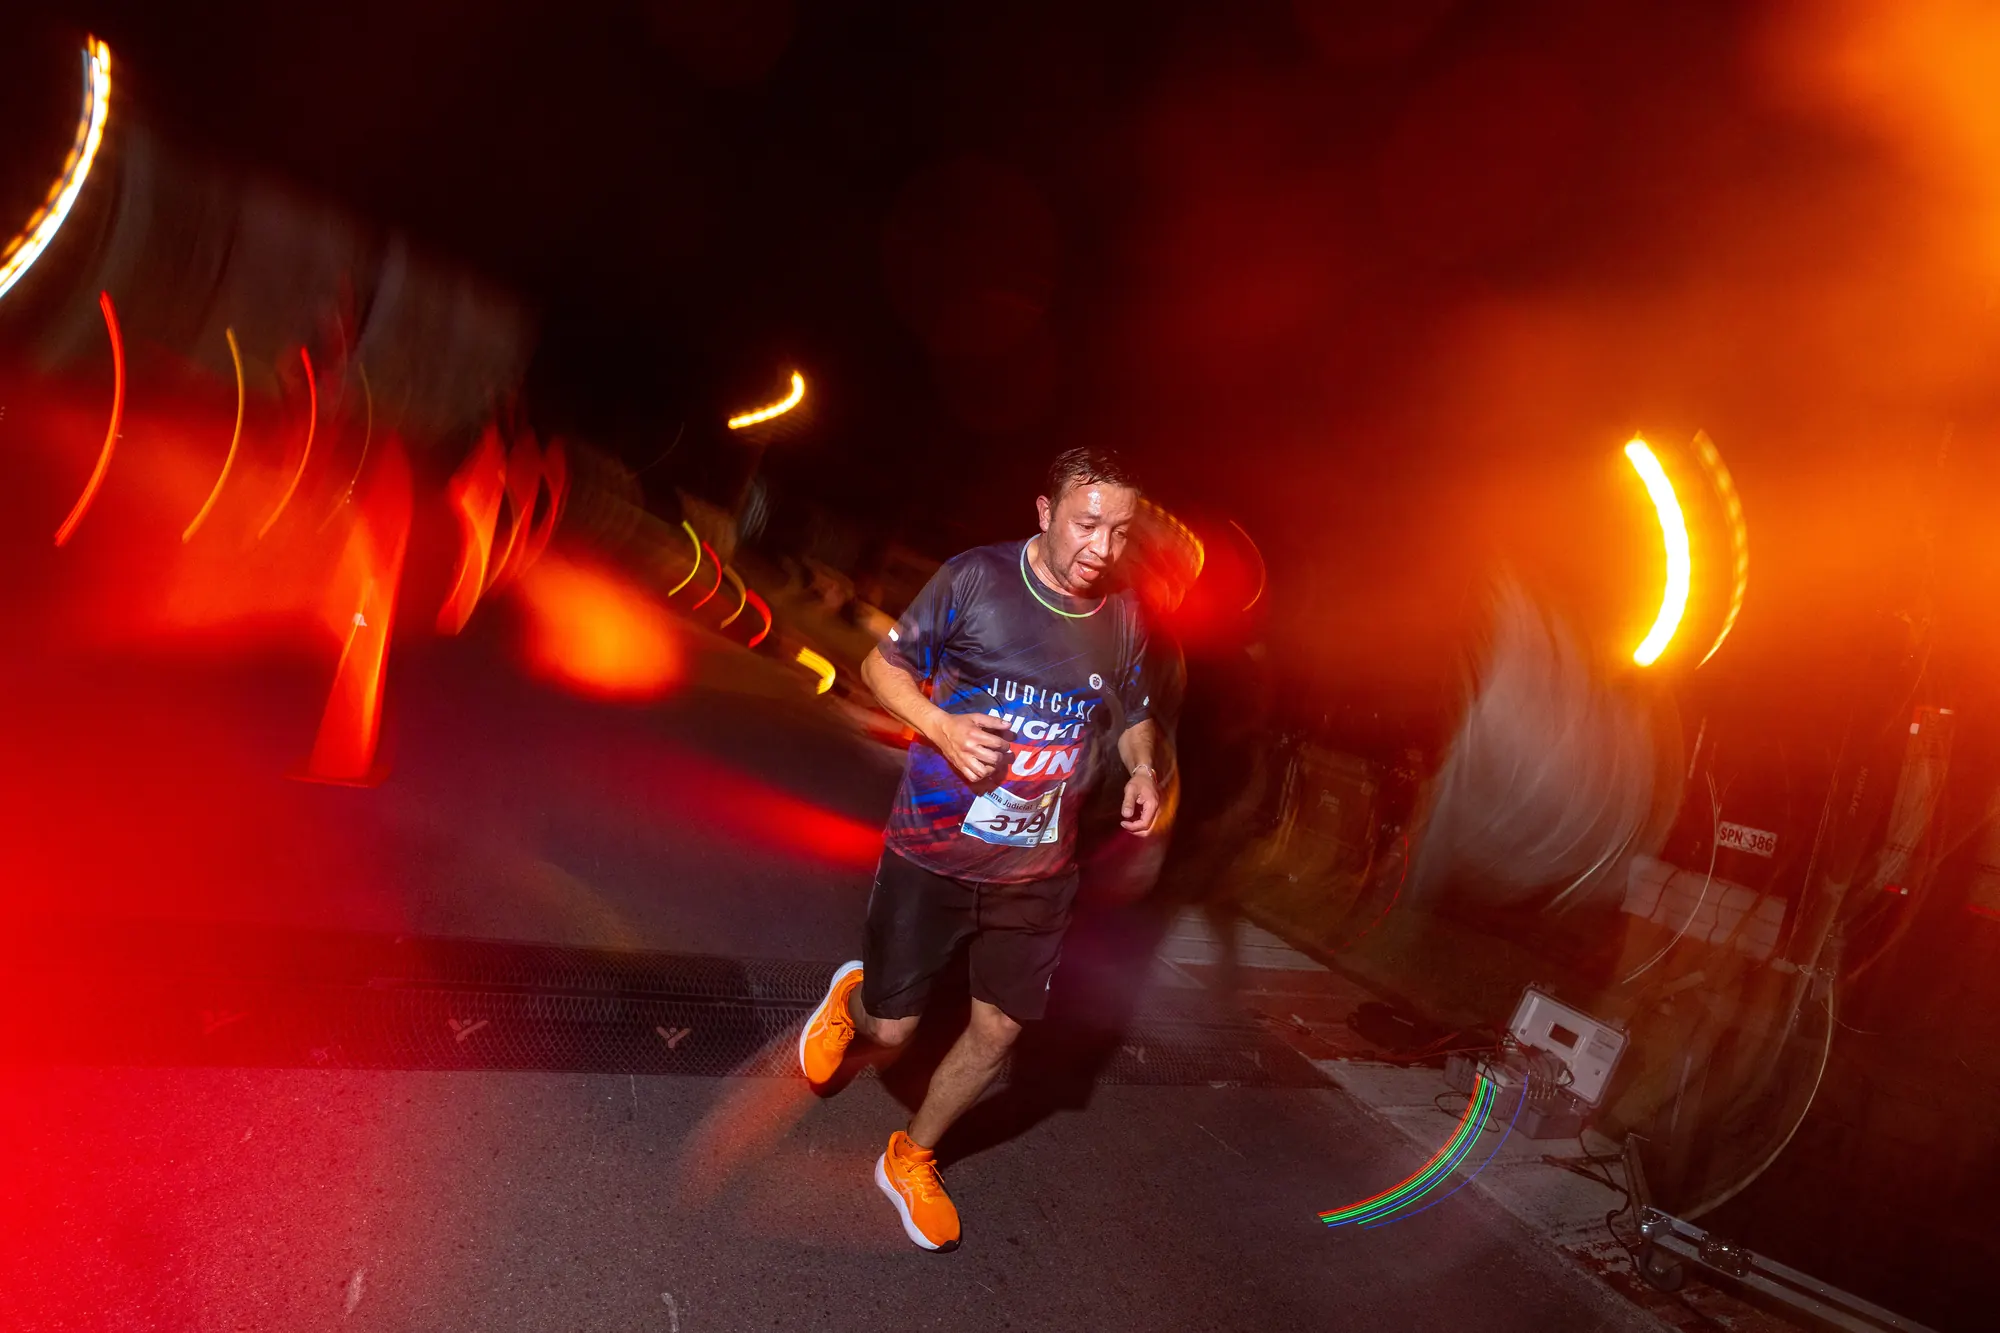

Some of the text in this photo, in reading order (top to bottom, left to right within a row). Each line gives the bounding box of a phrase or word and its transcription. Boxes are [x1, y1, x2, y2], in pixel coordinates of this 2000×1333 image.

[987, 677, 1096, 722] JUDICIAL
[1007, 748, 1080, 777] UN
[1003, 799, 1033, 811] Judicial
[989, 811, 1046, 835] 319
[1720, 826, 1774, 852] SPN 386
